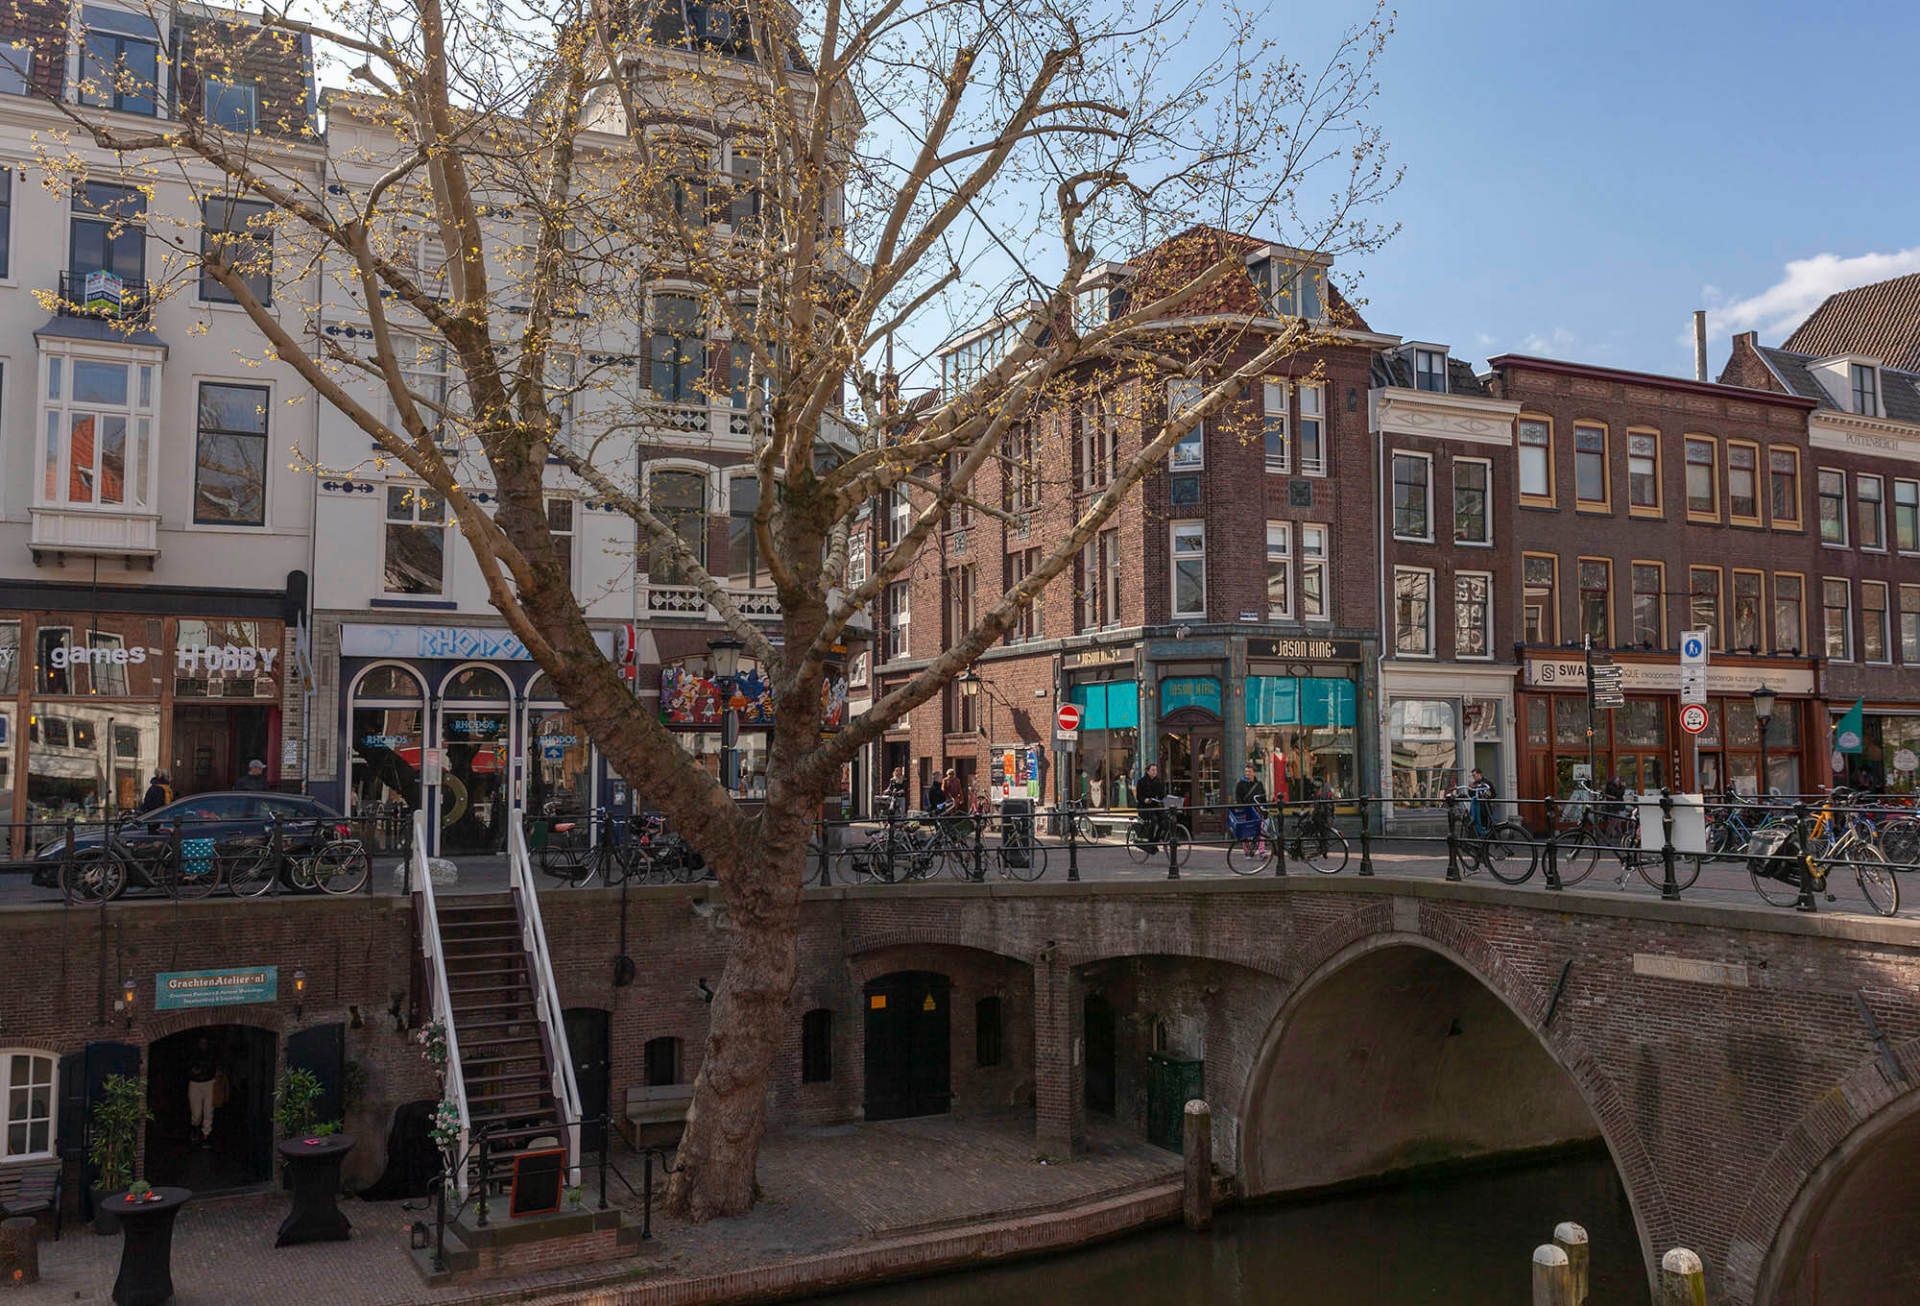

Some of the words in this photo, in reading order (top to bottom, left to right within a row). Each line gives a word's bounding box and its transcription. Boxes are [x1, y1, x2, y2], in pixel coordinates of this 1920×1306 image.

[418, 627, 533, 658] RHODO
[51, 646, 146, 669] games
[178, 643, 278, 672] HOBBY
[1559, 664, 1586, 676] SWA
[455, 720, 495, 729] RHODOS
